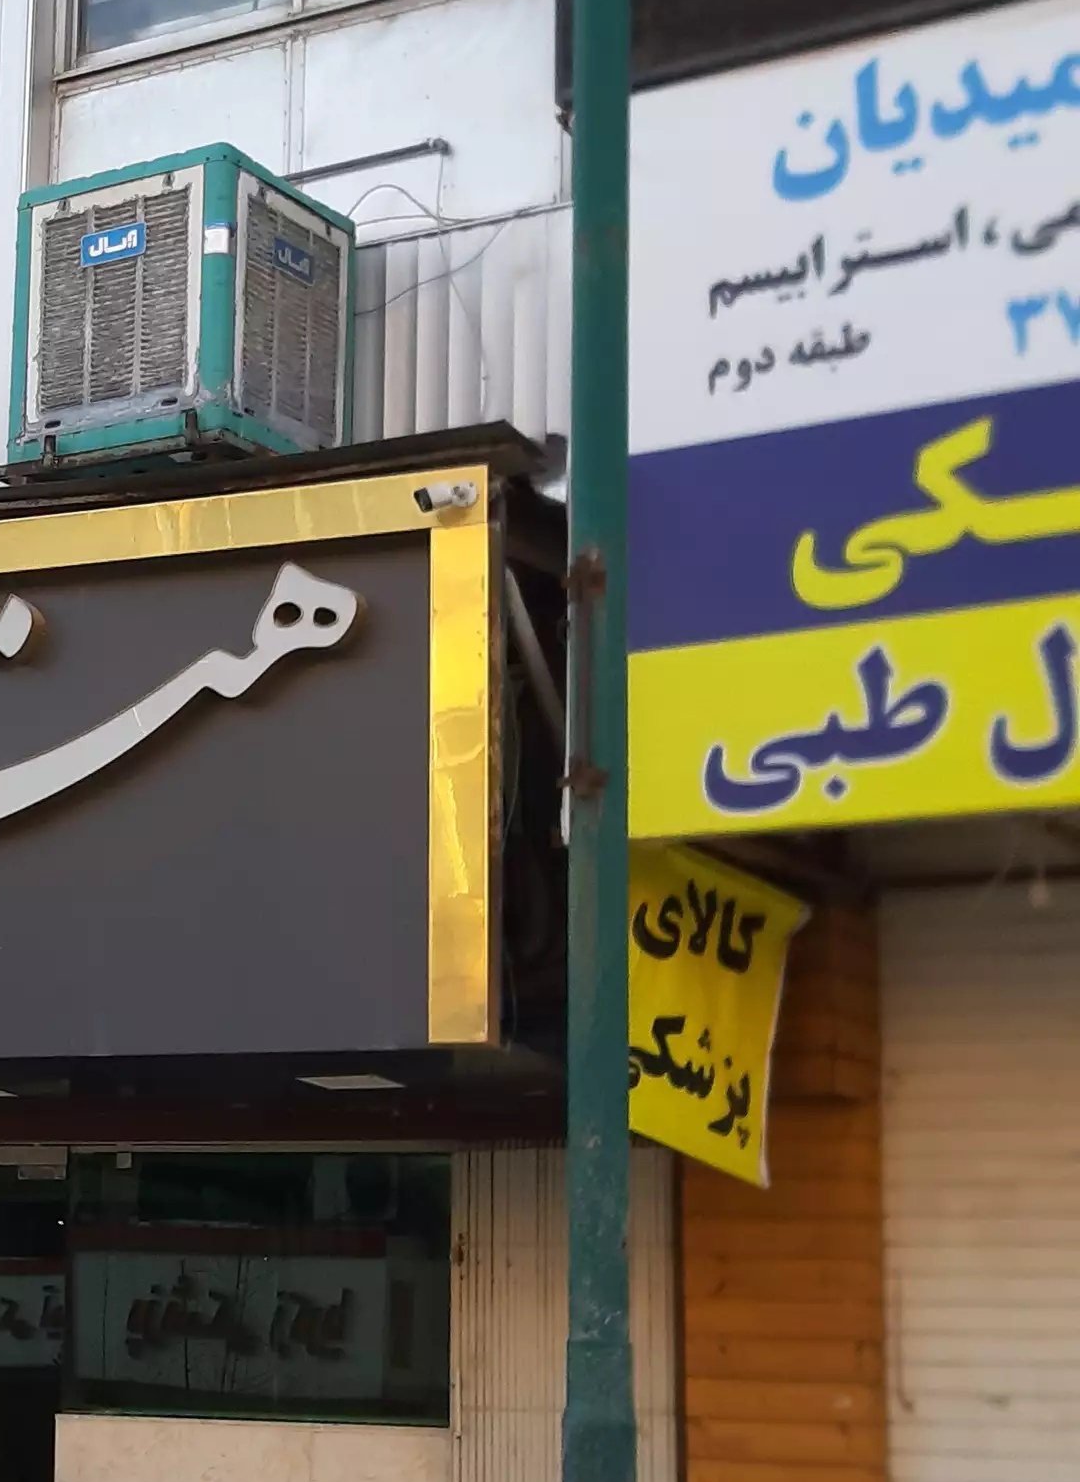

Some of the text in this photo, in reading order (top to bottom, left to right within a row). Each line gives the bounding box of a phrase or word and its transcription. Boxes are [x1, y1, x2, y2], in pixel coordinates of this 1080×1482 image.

[773, 55, 1080, 202] میدیان
[709, 205, 970, 320] استرابیسم
[708, 321, 871, 396] طبقه دوم
[704, 645, 950, 814] طبی
[632, 878, 767, 975] کالای
